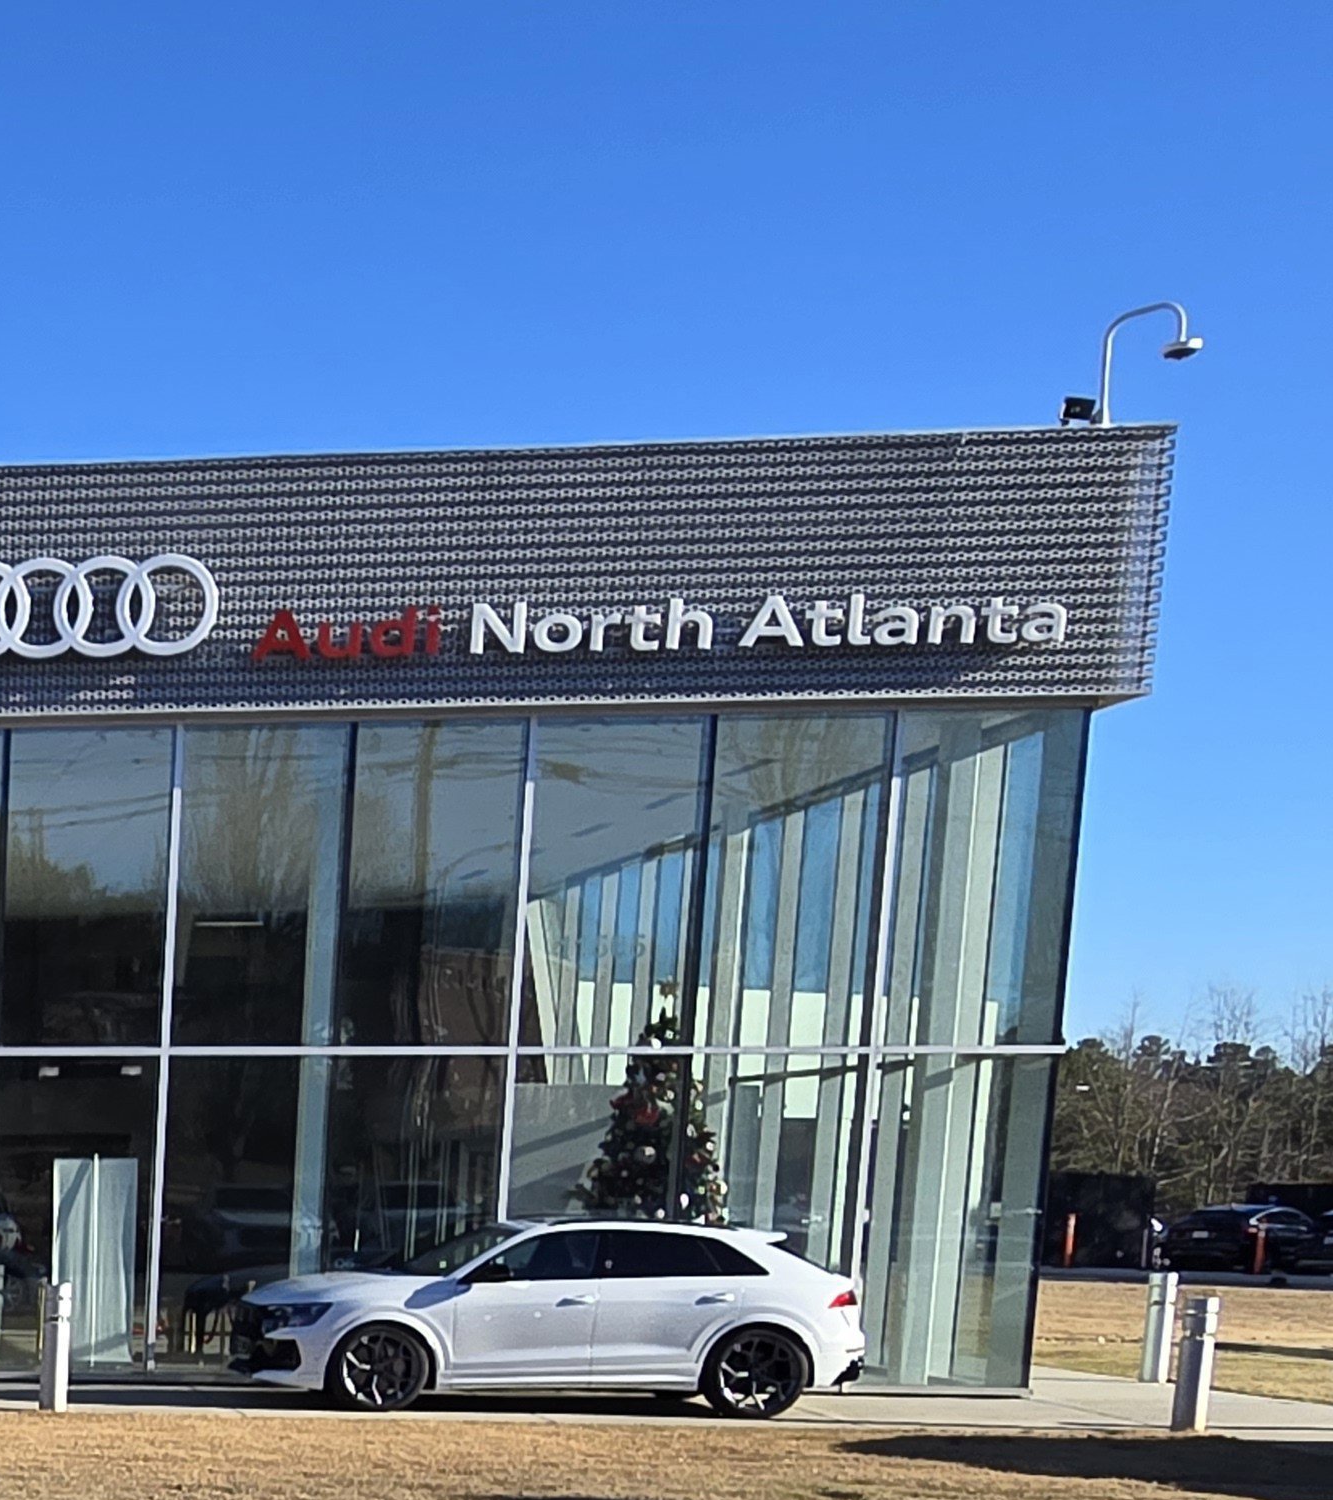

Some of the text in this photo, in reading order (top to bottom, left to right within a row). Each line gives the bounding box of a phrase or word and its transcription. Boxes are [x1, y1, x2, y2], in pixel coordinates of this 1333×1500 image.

[252, 593, 1067, 661] Audi North Atlanta
